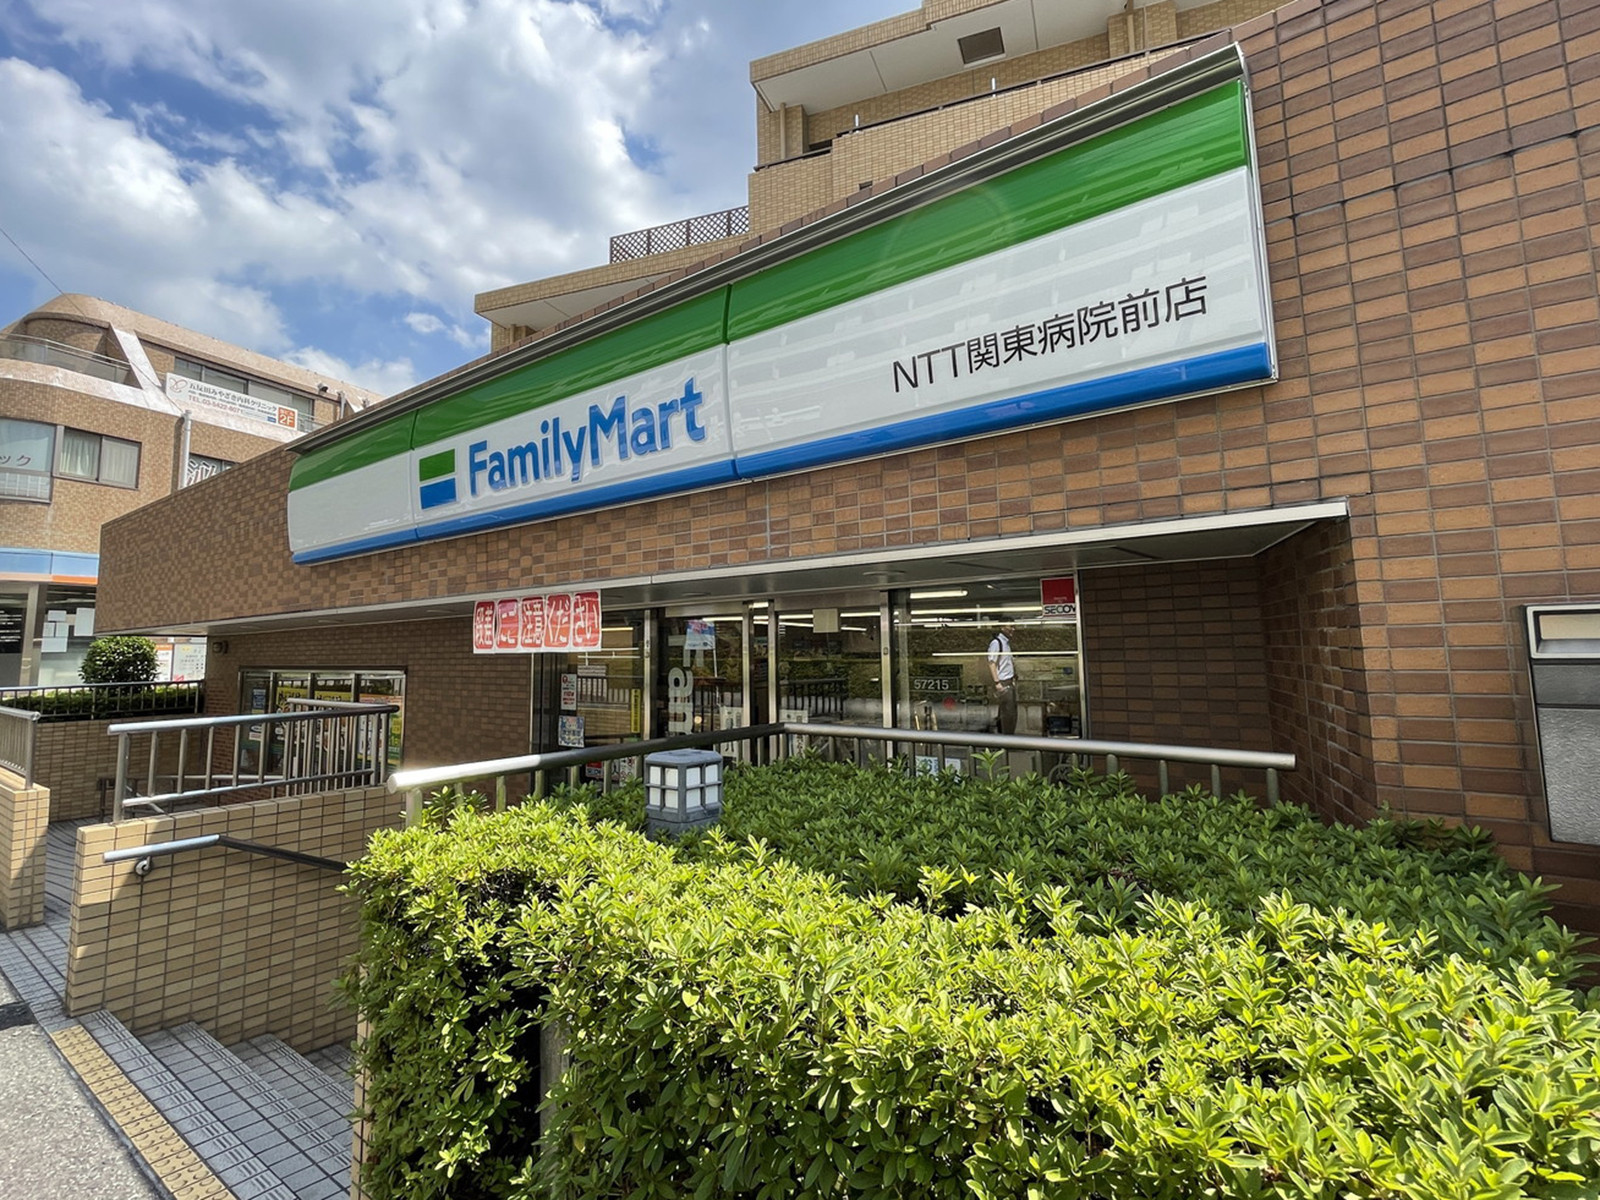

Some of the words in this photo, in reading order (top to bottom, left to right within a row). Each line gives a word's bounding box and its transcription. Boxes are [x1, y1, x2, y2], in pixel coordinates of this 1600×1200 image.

[892, 274, 1208, 393] NTT関東病院前店
[279, 414, 295, 427] 2F
[468, 376, 706, 497] FamilyMart
[913, 679, 950, 690] 57215
